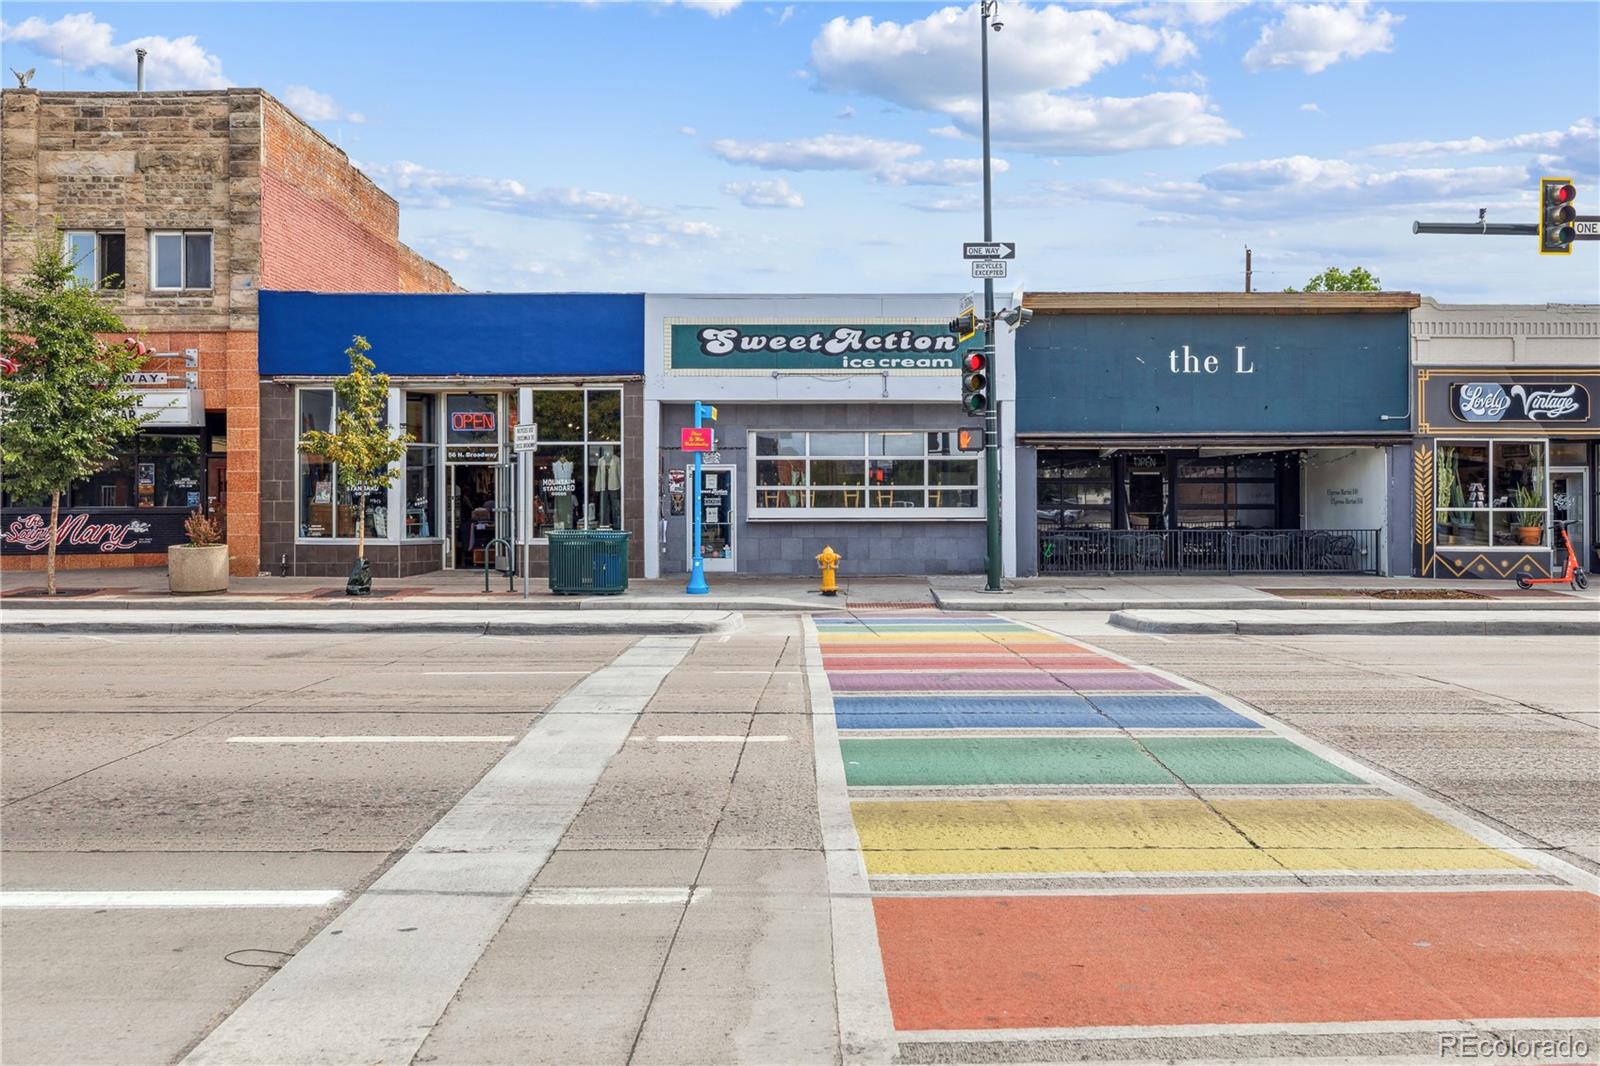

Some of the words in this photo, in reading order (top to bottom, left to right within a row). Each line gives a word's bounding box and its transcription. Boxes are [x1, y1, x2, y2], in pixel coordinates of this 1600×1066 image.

[1577, 223, 1598, 233] ONE
[968, 247, 983, 255] ONE
[985, 247, 1000, 255] WAY
[701, 328, 823, 354] Sweet
[824, 327, 957, 354] Action
[843, 356, 876, 367] ice
[878, 358, 953, 367] cream
[1169, 345, 1219, 374] the
[1235, 346, 1254, 374] L
[1460, 385, 1511, 416] Lovely
[1511, 384, 1579, 421] Vintage
[453, 414, 493, 429] OPEN
[466, 451, 497, 459] Broadway
[56, 512, 138, 552] Mary
